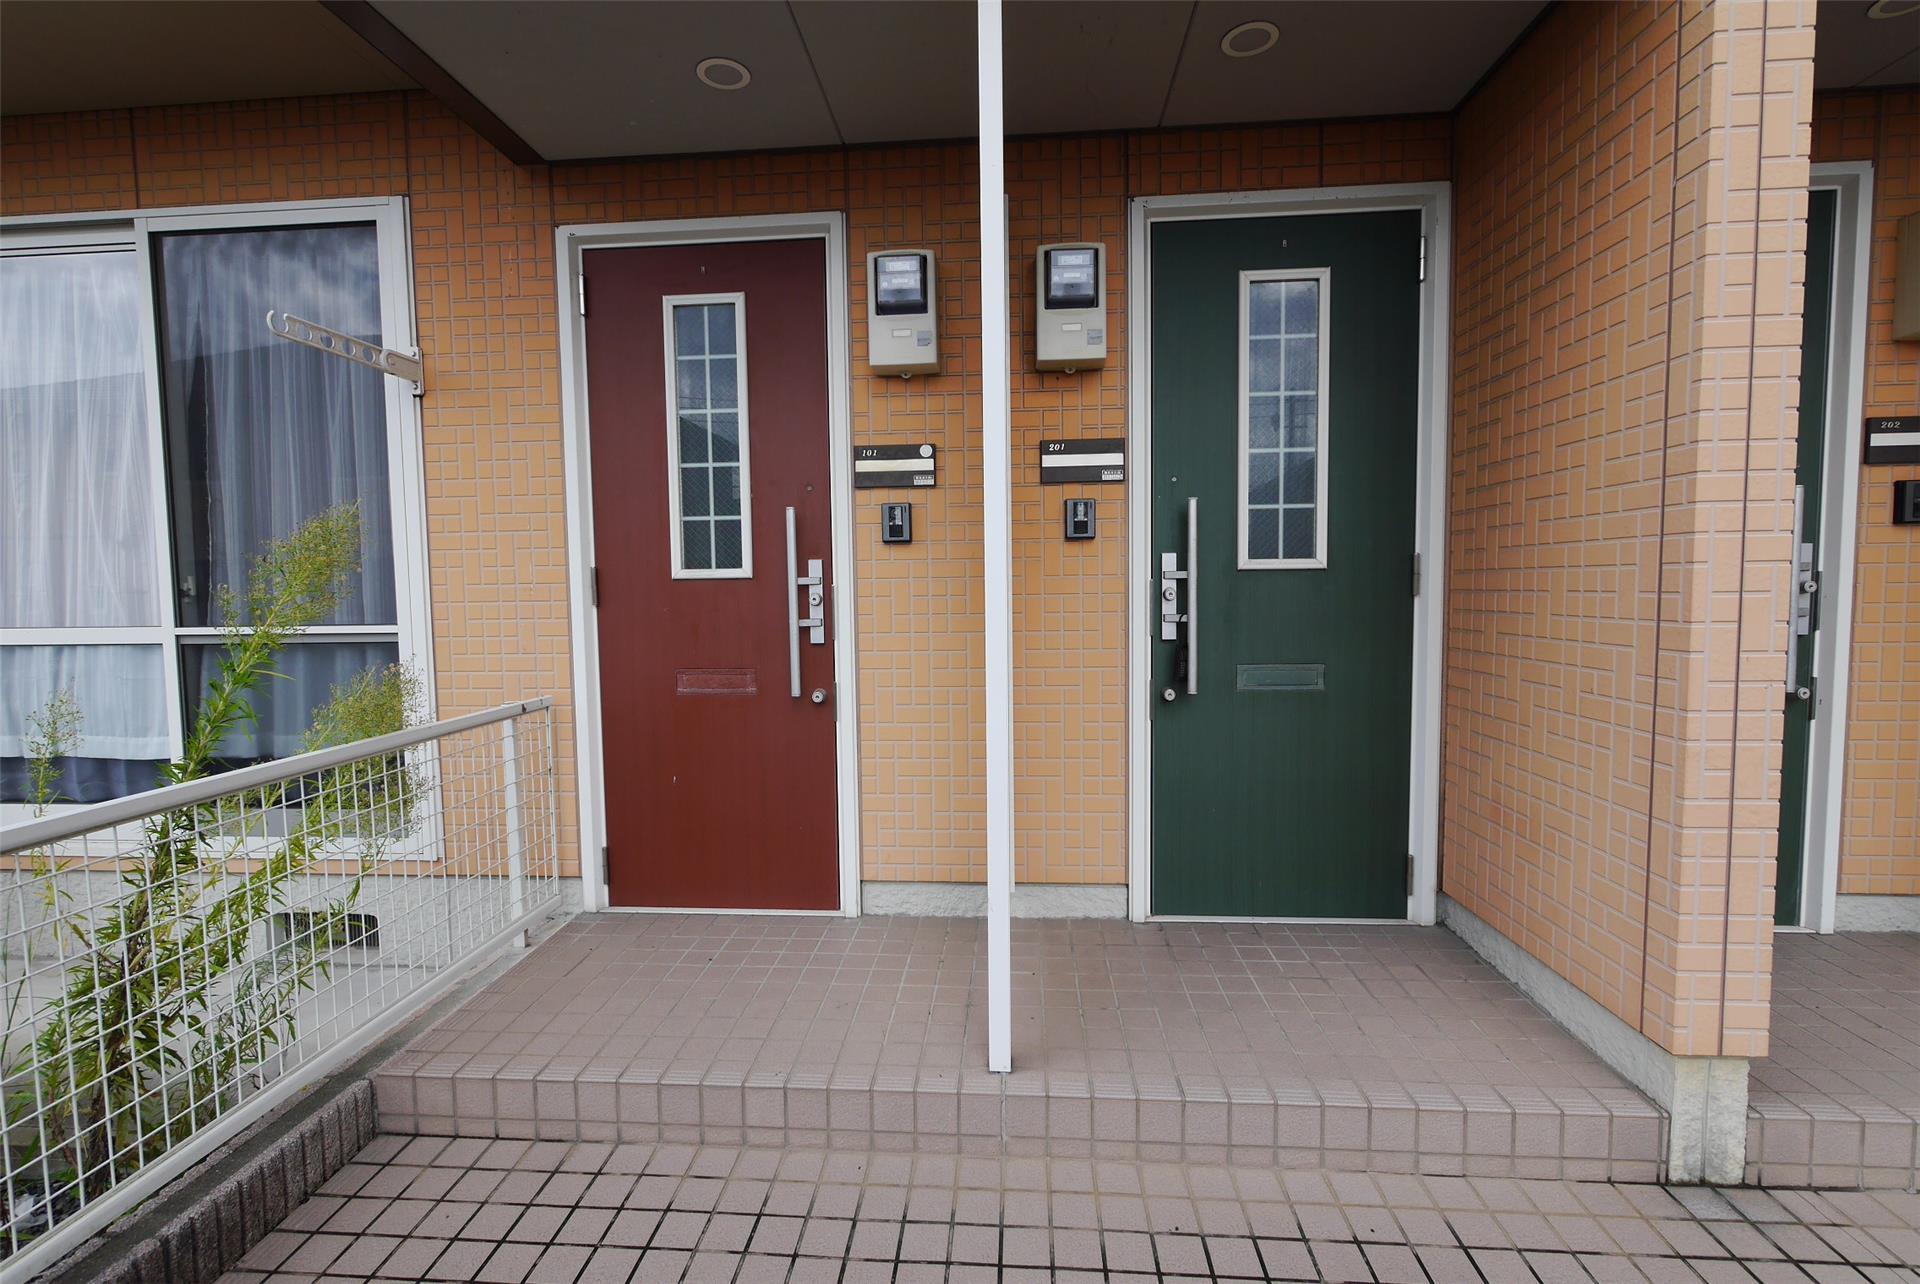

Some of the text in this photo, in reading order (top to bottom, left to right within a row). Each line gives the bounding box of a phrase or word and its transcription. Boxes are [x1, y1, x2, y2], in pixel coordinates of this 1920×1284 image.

[1881, 421, 1900, 429] 202
[1049, 443, 1065, 451] 201
[862, 449, 877, 457] 101
